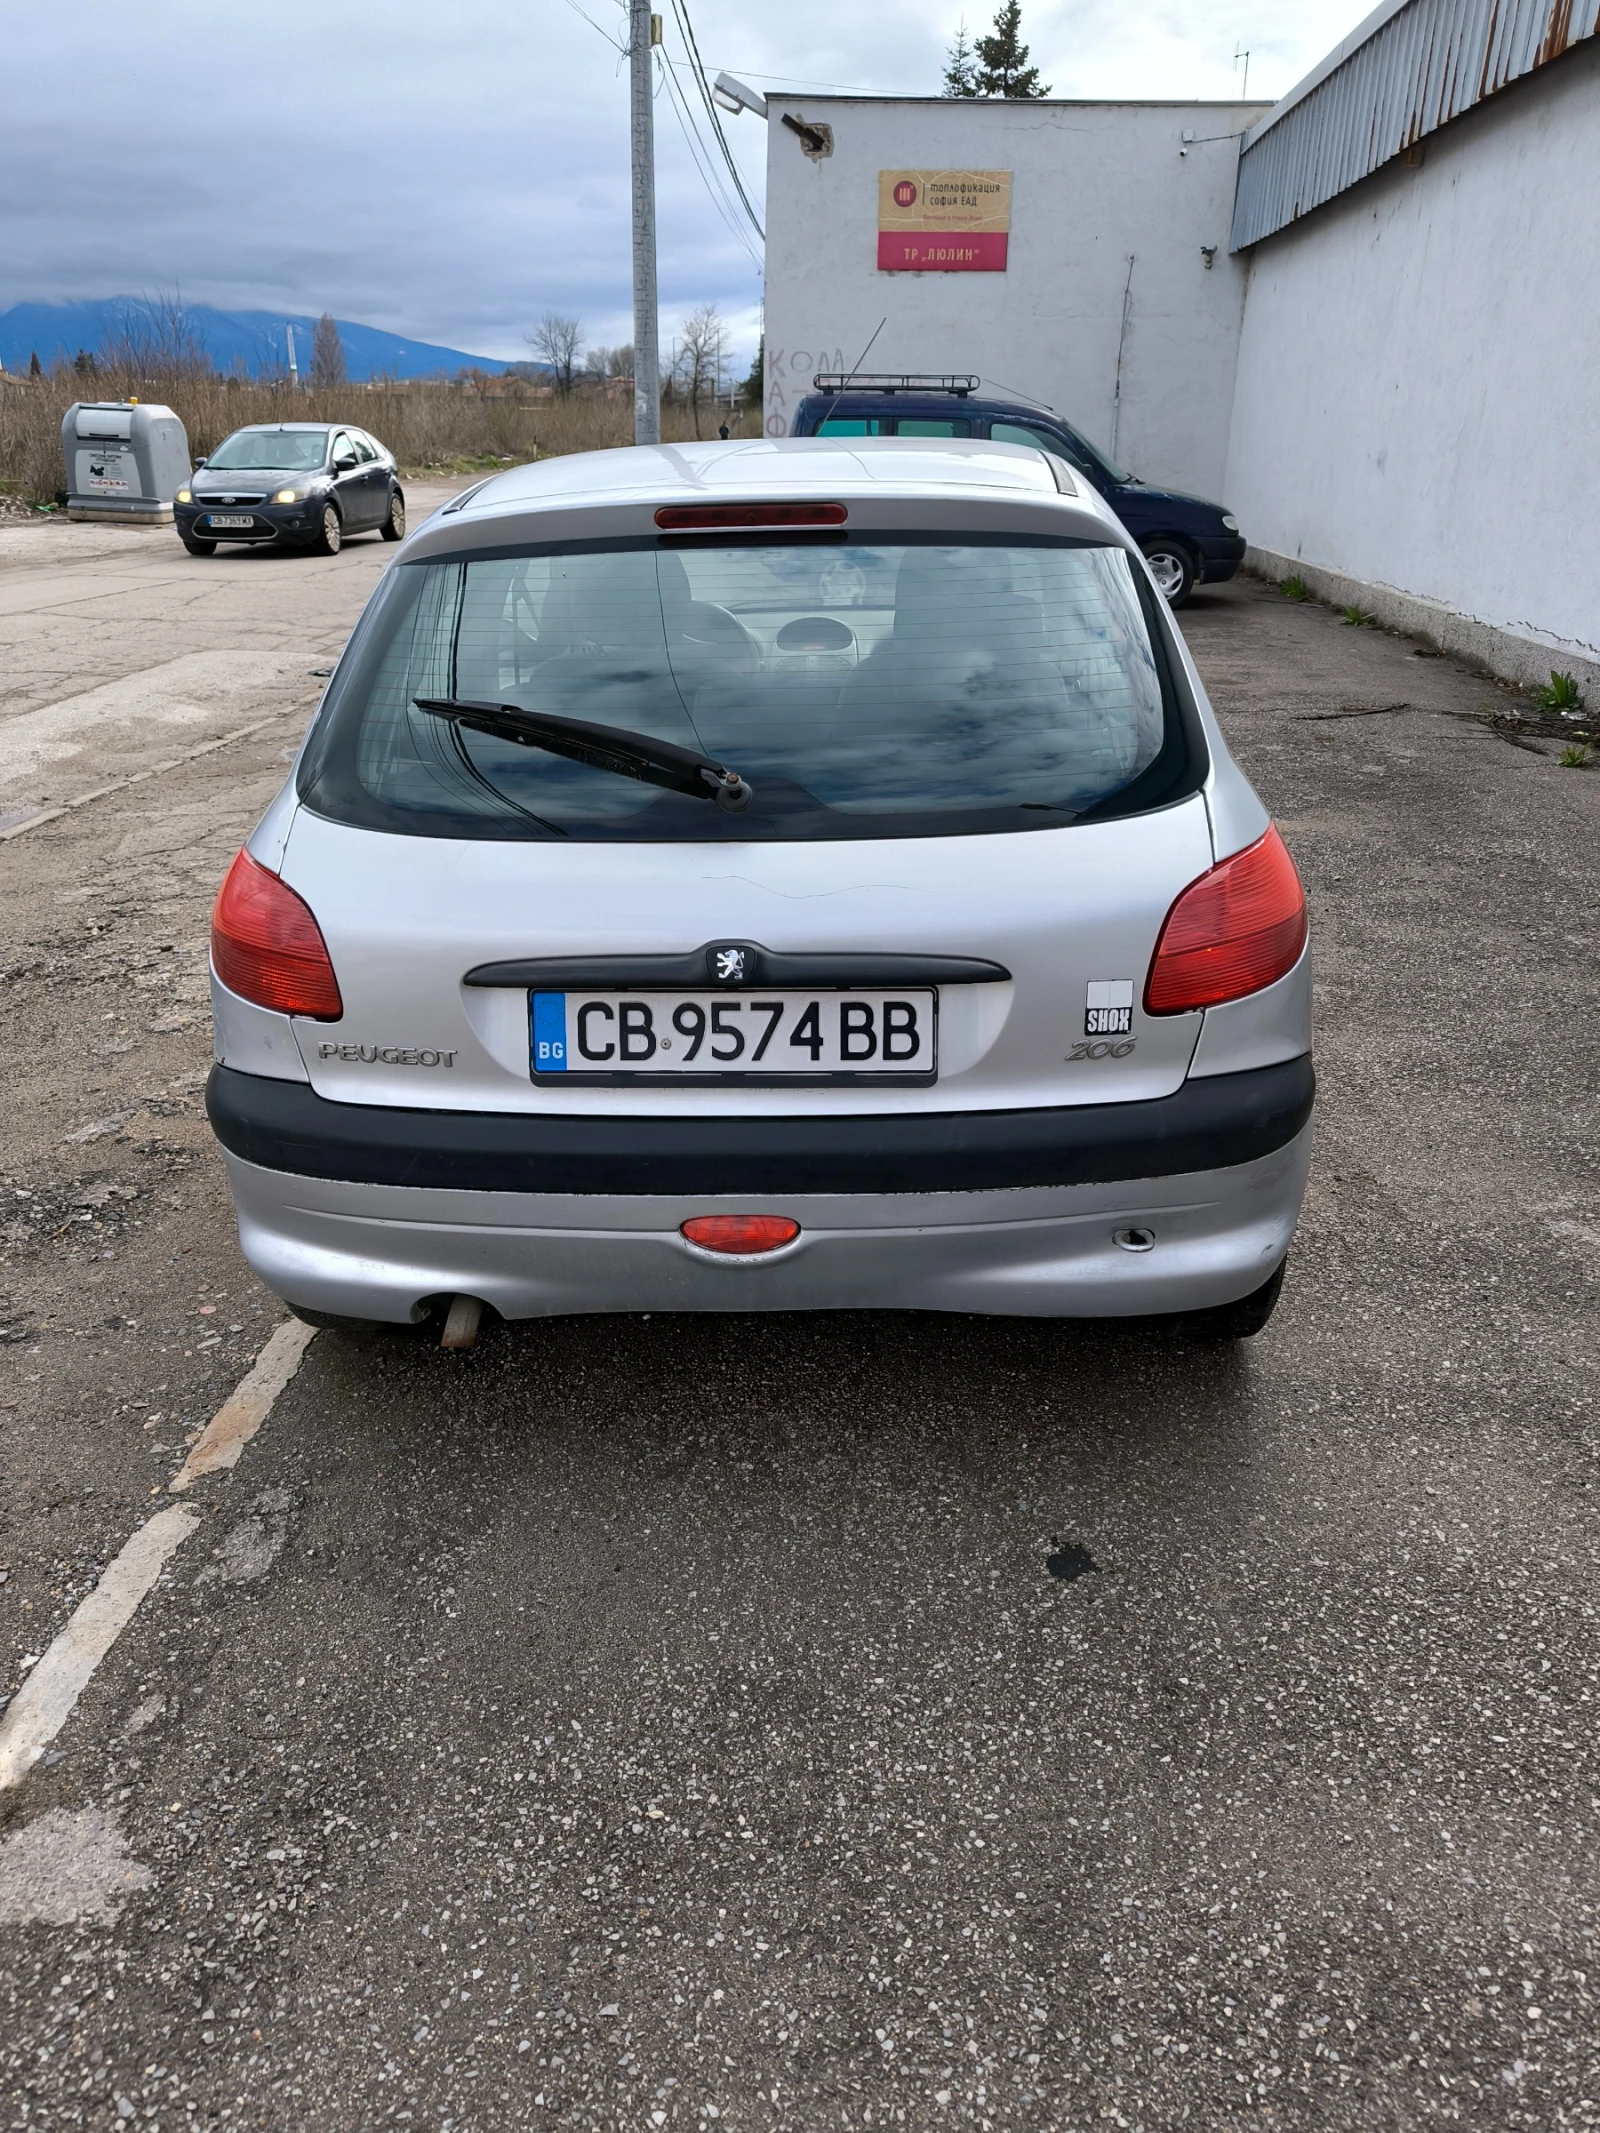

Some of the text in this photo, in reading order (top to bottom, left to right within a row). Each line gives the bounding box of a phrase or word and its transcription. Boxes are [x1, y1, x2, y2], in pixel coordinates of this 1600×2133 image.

[930, 183, 1000, 194] топлофикация
[930, 196, 978, 207] софия ЕАД
[904, 248, 919, 261] ТР
[1087, 1008, 1130, 1032] SHOX
[577, 1001, 921, 1061] CB 9574 BB
[317, 1041, 458, 1067] PEUGEOT
[538, 1041, 564, 1059] BG
[1064, 1035, 1138, 1061] 206
